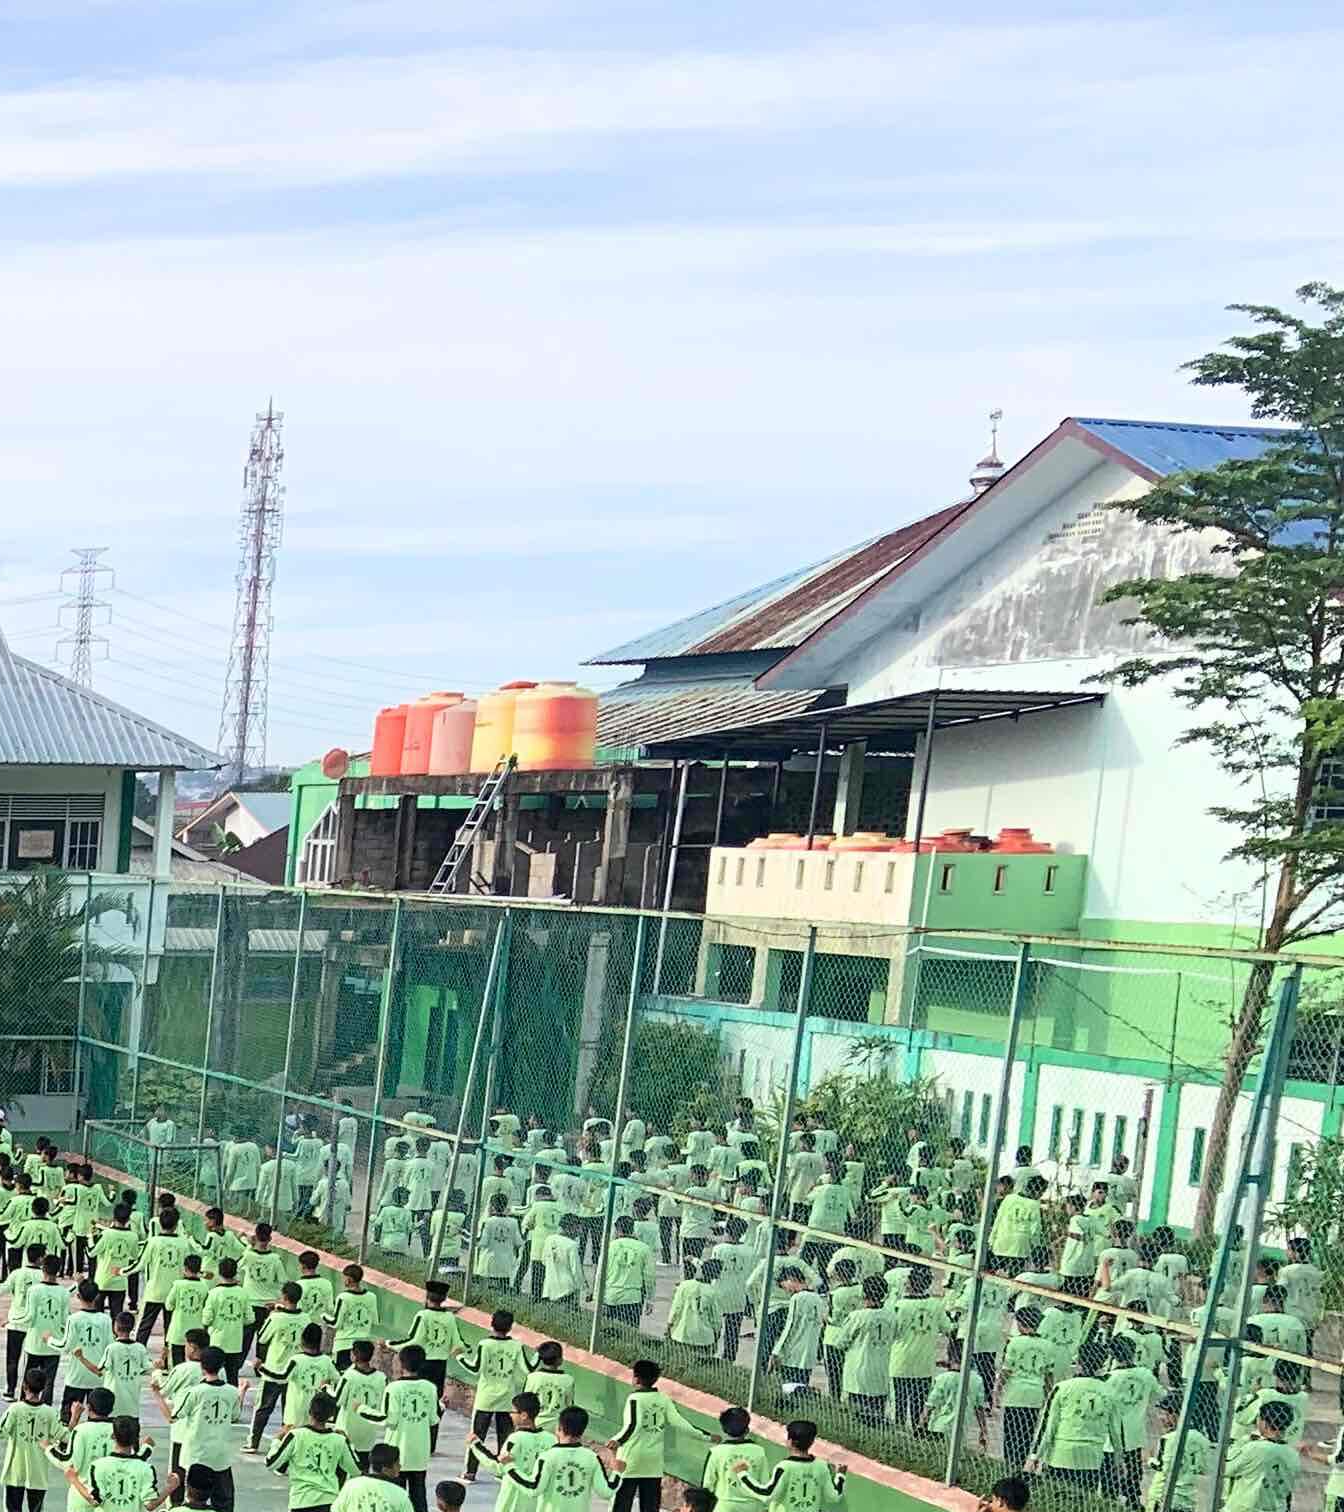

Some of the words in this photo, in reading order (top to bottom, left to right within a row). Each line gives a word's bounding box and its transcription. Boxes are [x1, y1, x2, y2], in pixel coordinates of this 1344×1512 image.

[85, 1327, 91, 1342] 1
[124, 1360, 130, 1376] 1
[212, 1401, 219, 1419] 1
[412, 1398, 417, 1414] 1
[652, 1411, 657, 1426] 1
[315, 1452, 321, 1469] 1
[568, 1469, 574, 1487] 1
[119, 1479, 124, 1495] 1
[802, 1482, 807, 1498] 1
